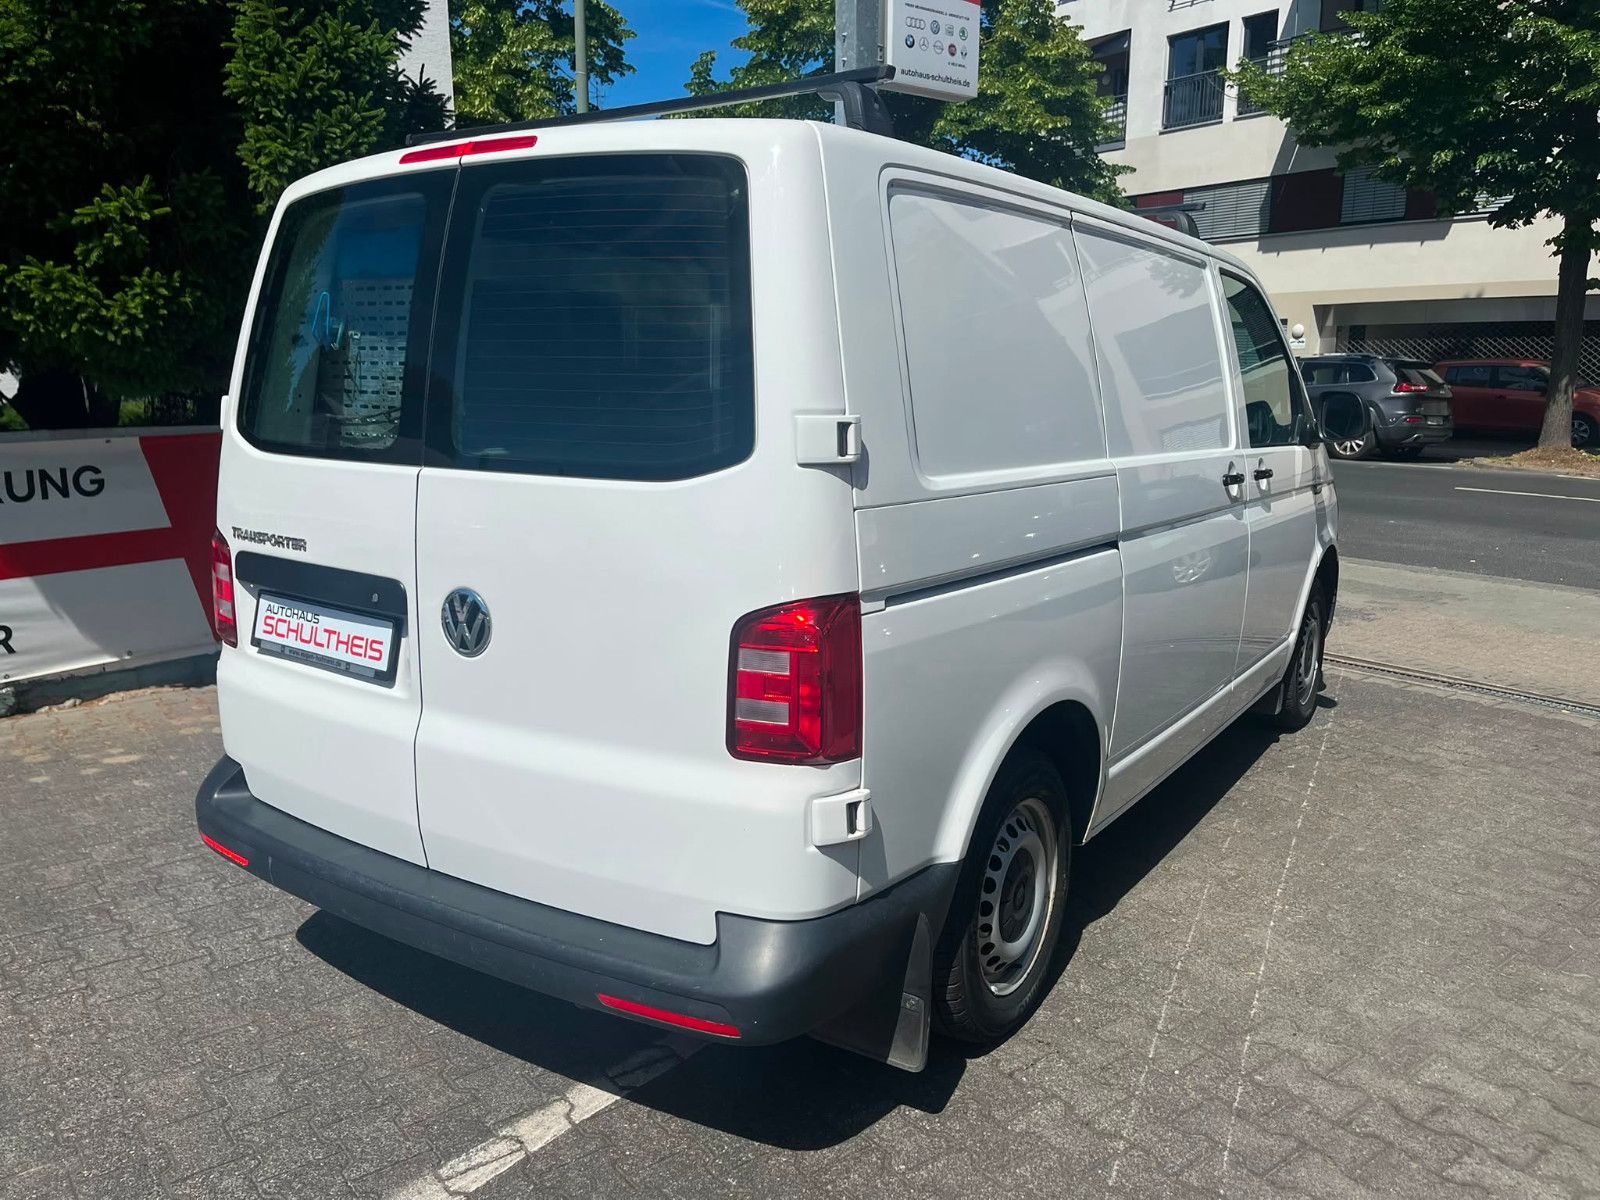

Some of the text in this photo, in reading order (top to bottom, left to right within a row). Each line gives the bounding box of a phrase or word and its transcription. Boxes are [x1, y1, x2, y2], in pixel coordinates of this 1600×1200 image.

[900, 67, 970, 88] autohaus-schultheis.de
[0, 465, 105, 504] UNG
[231, 526, 307, 552] TRANSPORTER
[265, 603, 320, 624] AUTOHAUS
[262, 615, 384, 662] SCHULTHEIS
